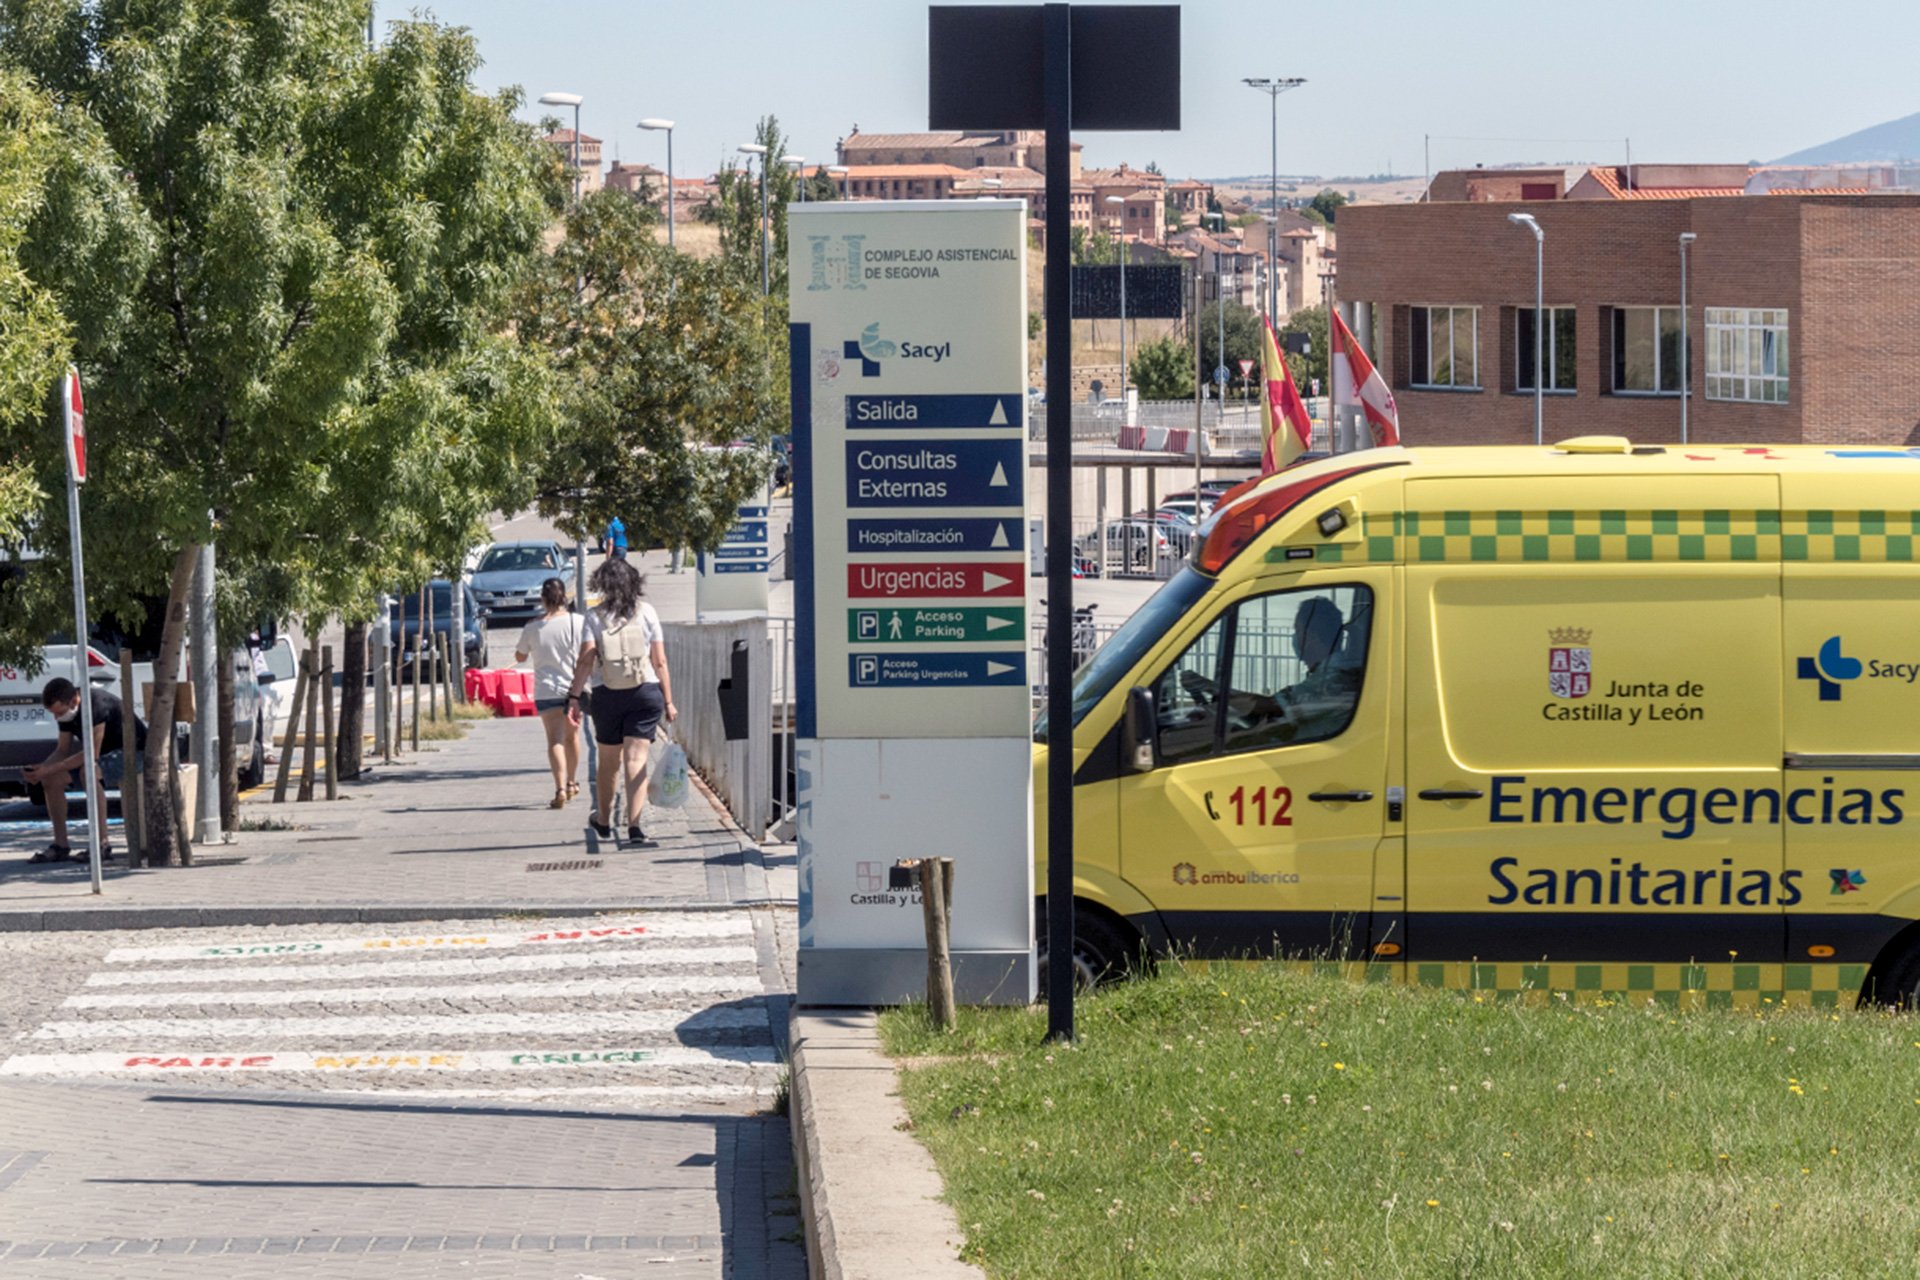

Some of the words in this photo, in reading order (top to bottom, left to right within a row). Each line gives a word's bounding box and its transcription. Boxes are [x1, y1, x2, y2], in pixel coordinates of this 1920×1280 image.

[864, 249, 933, 263] COMPLEJO
[936, 248, 1018, 261] ASISTENCIAL
[864, 266, 882, 279] DE
[885, 266, 940, 279] SEGOVIA
[900, 341, 951, 362] Sacyl
[856, 400, 918, 421] Salida
[857, 450, 957, 470] Consultas
[858, 479, 947, 498] Externas
[858, 528, 964, 546] Hospitalización
[860, 567, 966, 594] Urgencias
[915, 610, 964, 622] Acceso
[915, 625, 965, 639] Parking
[883, 659, 918, 668] Acceso
[883, 669, 919, 680] Parking
[921, 668, 968, 680] Urgencias
[1605, 680, 1669, 699] Junta
[1676, 680, 1704, 698] de
[1542, 703, 1622, 721] Castilla
[1627, 706, 1643, 725] y
[1649, 703, 1704, 721] León
[1229, 785, 1293, 826] 112
[1488, 775, 1906, 840] Emergencias
[1488, 857, 1804, 906] Sanitarias
[850, 893, 897, 905] Castilla
[899, 895, 908, 908] y
[124, 1055, 274, 1068] PARE
[511, 1051, 661, 1066] CRUCE
